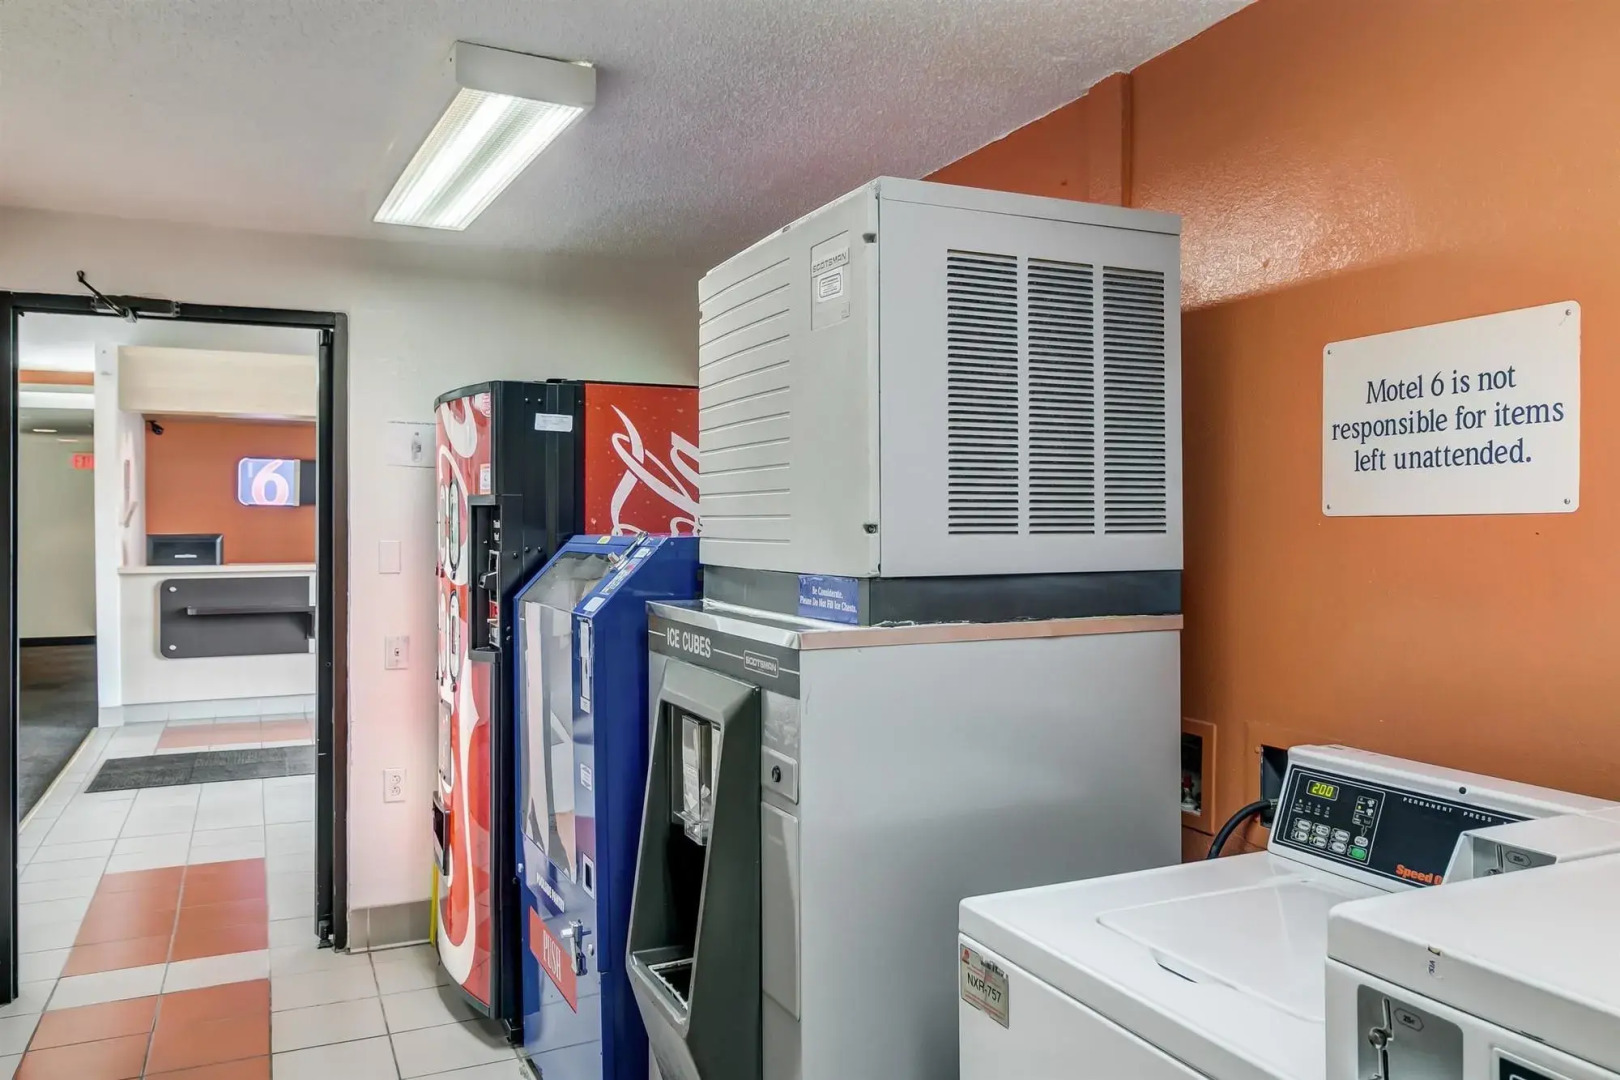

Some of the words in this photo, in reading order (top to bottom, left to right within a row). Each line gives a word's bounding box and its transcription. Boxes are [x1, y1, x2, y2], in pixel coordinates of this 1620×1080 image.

[812, 252, 847, 273] SCOTSMAN
[1365, 374, 1424, 404] Motel
[1431, 371, 1445, 397] 6
[1452, 370, 1470, 394] is
[1477, 365, 1517, 392] not
[1332, 406, 1448, 444] responsible
[1455, 405, 1487, 429] for
[1494, 401, 1565, 427] items
[1354, 448, 1387, 472] left
[1393, 437, 1533, 470] unattended.
[251, 459, 290, 505] 6
[667, 627, 680, 648] ICE
[682, 631, 711, 659] CUBES
[745, 655, 777, 672] SCOTSMAN
[1311, 782, 1334, 798] 200
[1403, 797, 1454, 814] PERMANENT
[1463, 811, 1493, 823] PRESS
[1395, 863, 1433, 885] Speed
[542, 928, 562, 983] PUSH
[967, 973, 1002, 1003] NXR-757
